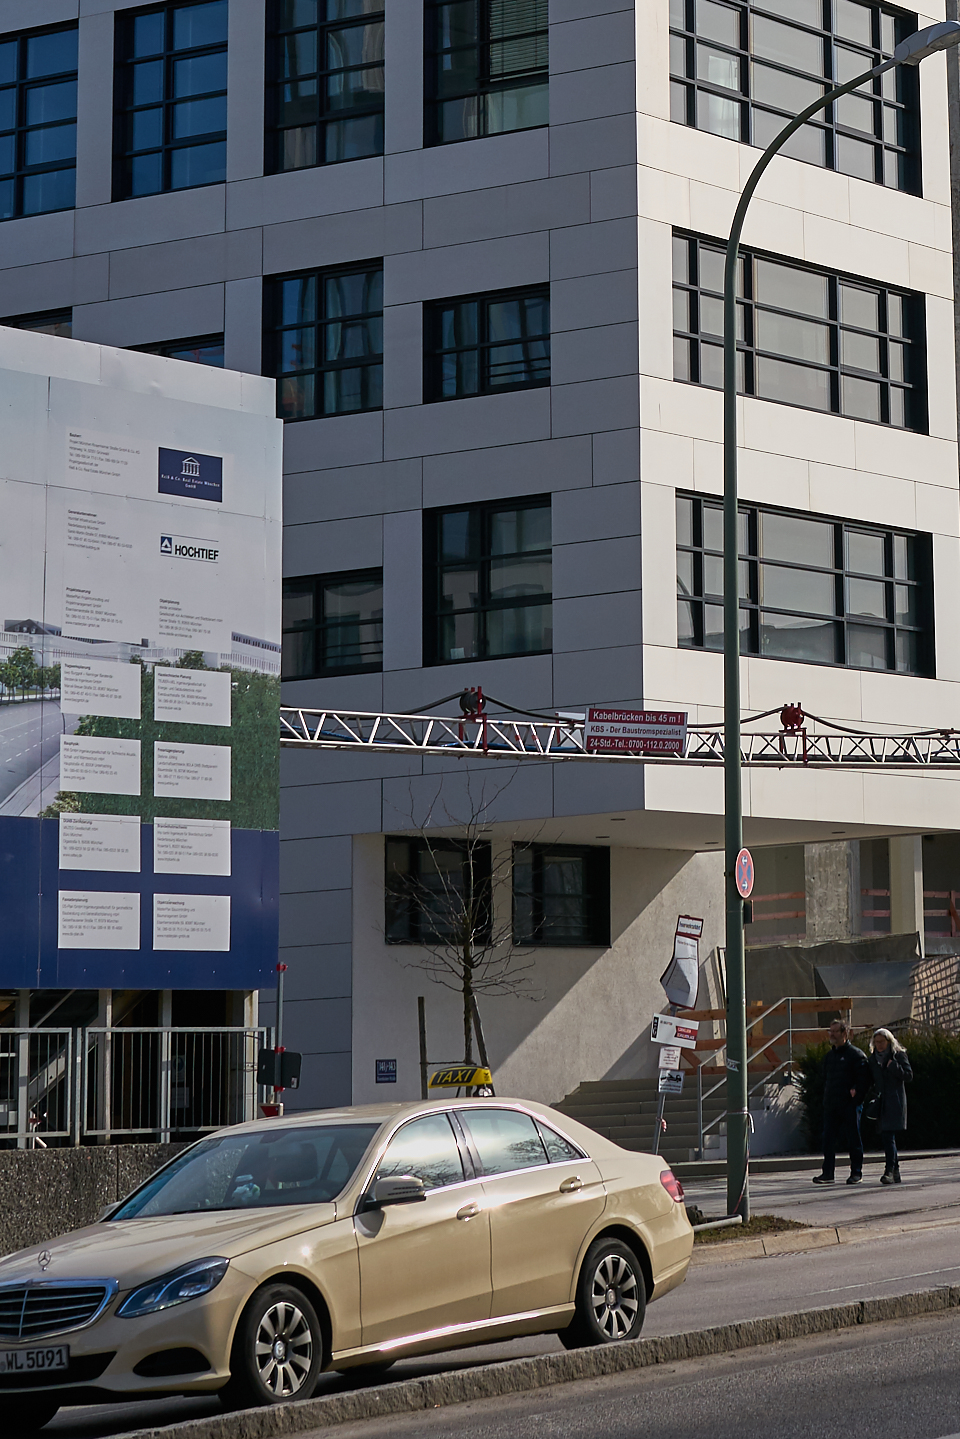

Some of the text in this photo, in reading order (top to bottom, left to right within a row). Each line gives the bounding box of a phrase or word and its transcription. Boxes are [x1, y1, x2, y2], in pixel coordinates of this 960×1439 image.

[174, 544, 219, 561] HOCHTIEF
[593, 711, 644, 722] Kabelbrücken
[645, 714, 657, 722] bis
[658, 714, 668, 723] 45
[590, 725, 605, 733] KBS
[622, 726, 681, 736] Baustromspezialist
[436, 1069, 472, 1084] TAXI
[5, 1348, 66, 1370] WL 5091
